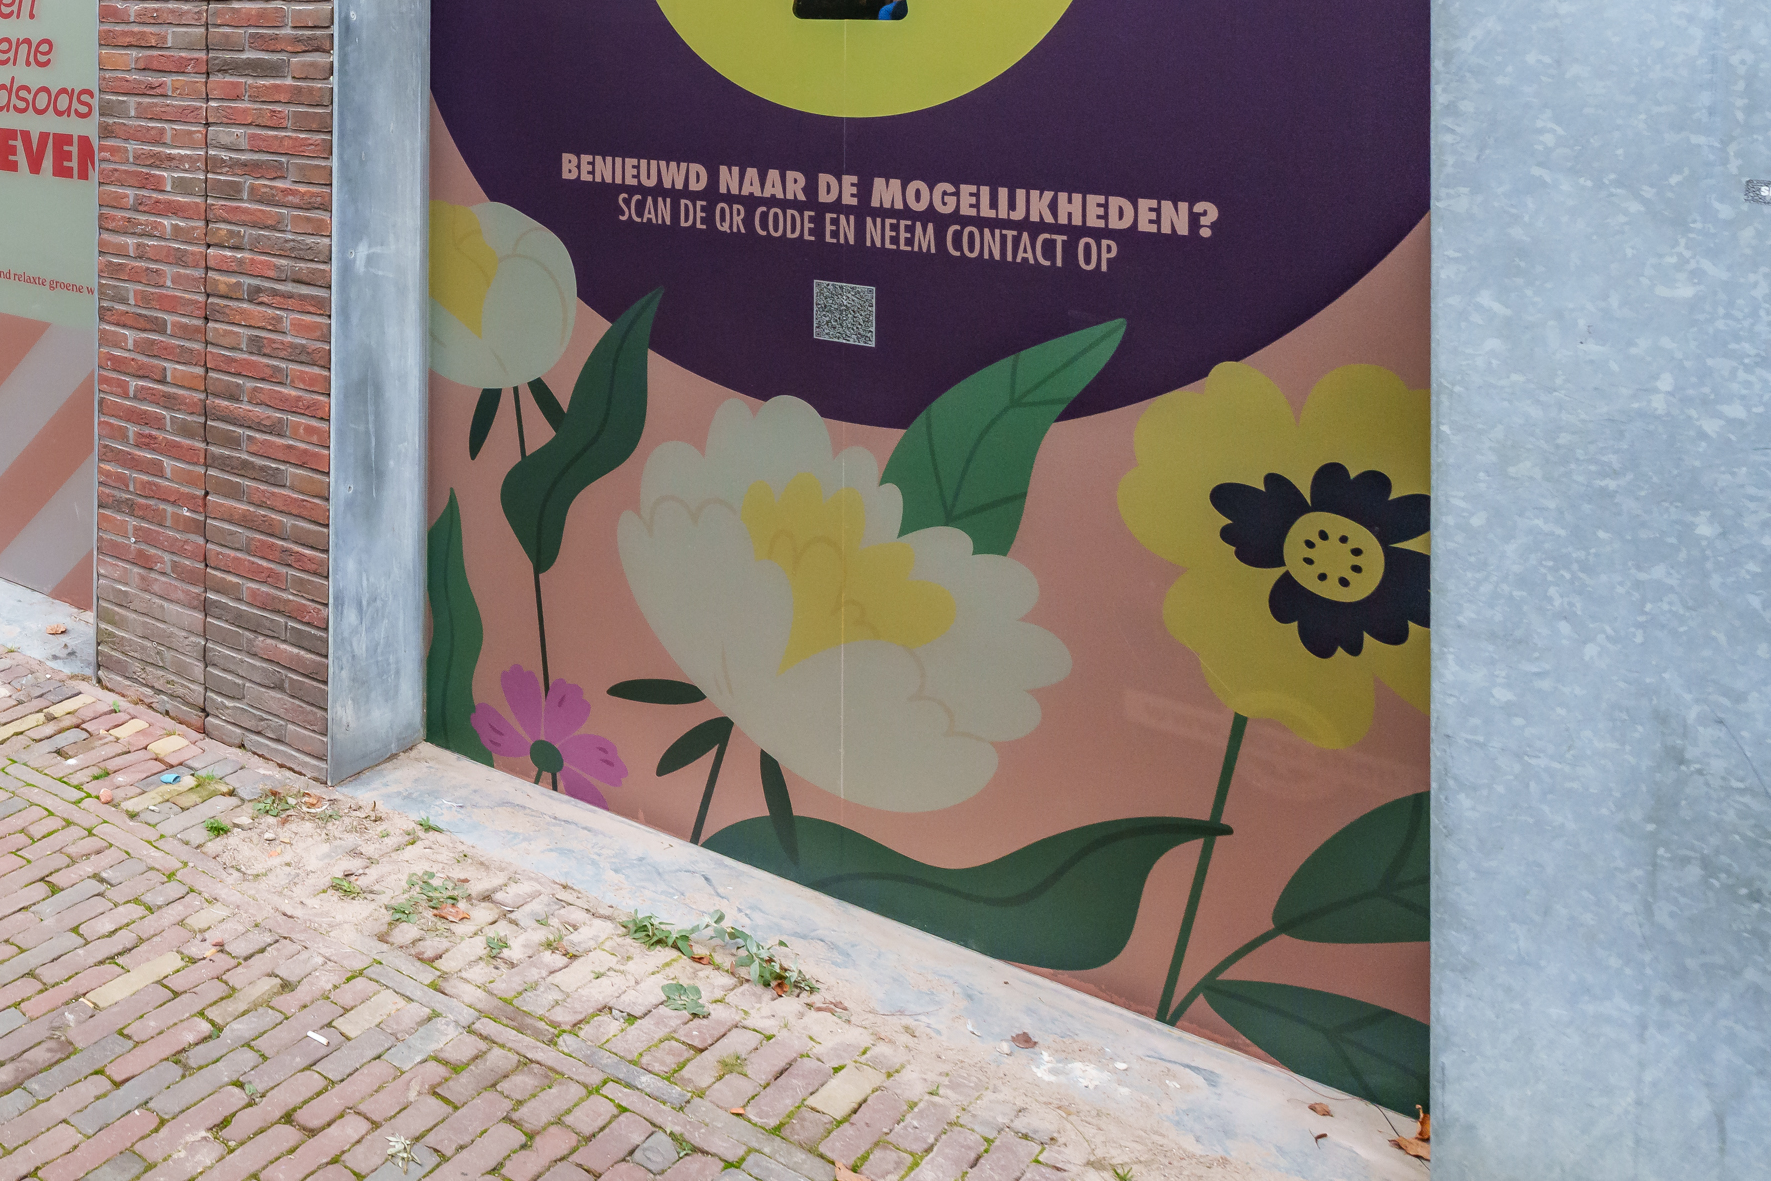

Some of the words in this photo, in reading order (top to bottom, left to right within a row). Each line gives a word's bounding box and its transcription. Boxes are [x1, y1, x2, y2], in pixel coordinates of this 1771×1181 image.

[561, 152, 708, 191] BENIEUWD
[718, 165, 807, 201] NAAR
[817, 173, 858, 206] DE
[871, 177, 1219, 238] MOGELIJKHEDEN?
[617, 193, 671, 225] SCAN
[679, 198, 707, 229] DE
[715, 202, 746, 233] QR
[754, 206, 816, 241] CODE
[825, 213, 855, 245] EN
[865, 217, 936, 254] NEEM
[946, 224, 1068, 267] CONTACT
[1077, 237, 1118, 272] OP
[13, 271, 47, 286] relaxte
[49, 279, 84, 294] groene
